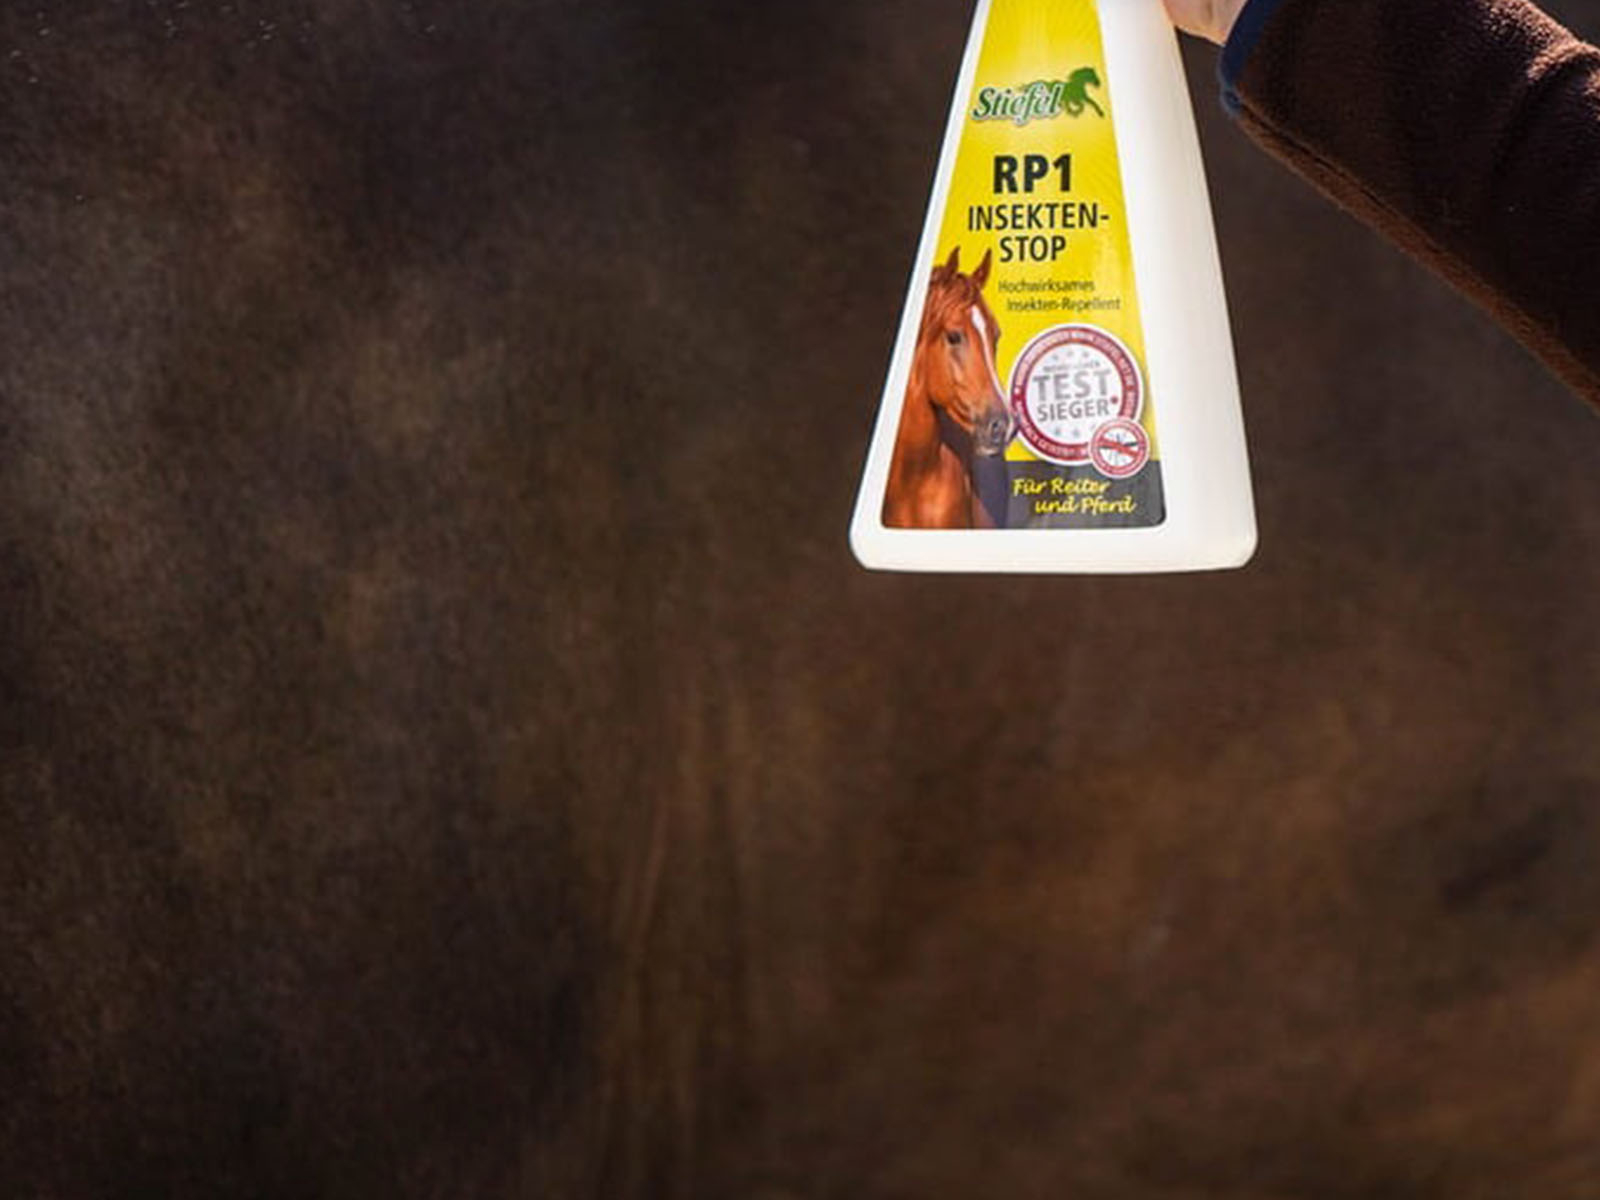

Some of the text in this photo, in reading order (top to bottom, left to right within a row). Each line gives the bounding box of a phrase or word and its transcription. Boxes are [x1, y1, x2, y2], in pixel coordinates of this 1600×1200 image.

[973, 83, 1063, 126] Stiefel
[993, 153, 1071, 194] RP1
[968, 202, 1110, 231] INSEKTEN-
[1000, 236, 1066, 263] STOP
[998, 279, 1095, 293] Hochwirksames
[1007, 297, 1121, 313] Insekten-Repellent
[1032, 370, 1111, 401] TEST
[1037, 400, 1109, 422] SIEGER
[1013, 478, 1110, 496] Für Reiter
[1035, 495, 1136, 515] und Pferd
